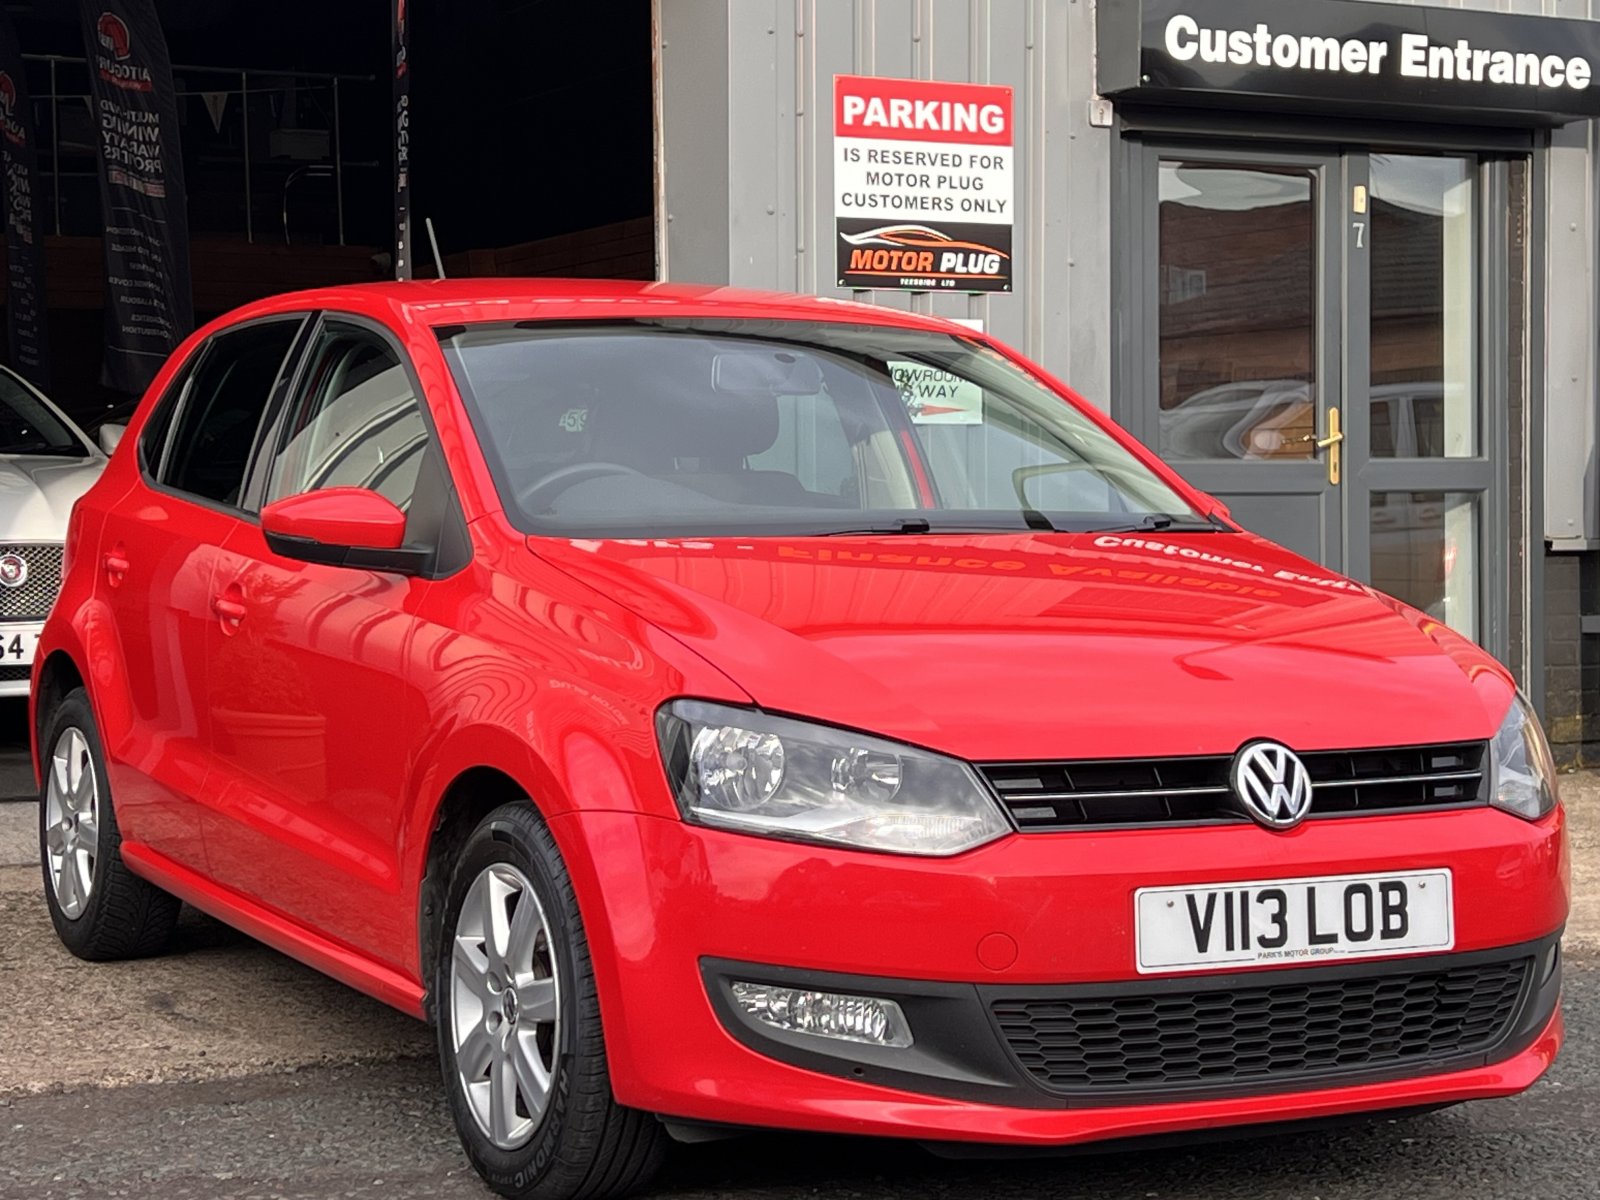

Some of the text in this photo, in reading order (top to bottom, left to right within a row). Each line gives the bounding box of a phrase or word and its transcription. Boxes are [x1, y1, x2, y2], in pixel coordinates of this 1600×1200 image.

[1165, 14, 1592, 90] Customer Entrance
[843, 95, 1005, 134] PARKING
[843, 148, 1004, 170] IS RESERVED FOR
[866, 171, 984, 190] MOTOR PLUG
[841, 192, 1007, 214] CUSTOMERS ONLY
[1352, 222, 1366, 249] 7
[850, 249, 1001, 274] MOTOR PLUG
[918, 384, 959, 398] WAY
[0, 634, 24, 660] 4
[1185, 881, 1409, 954] V113 LOB
[1284, 948, 1309, 958] MOTOR
[1310, 947, 1334, 956] GROUP
